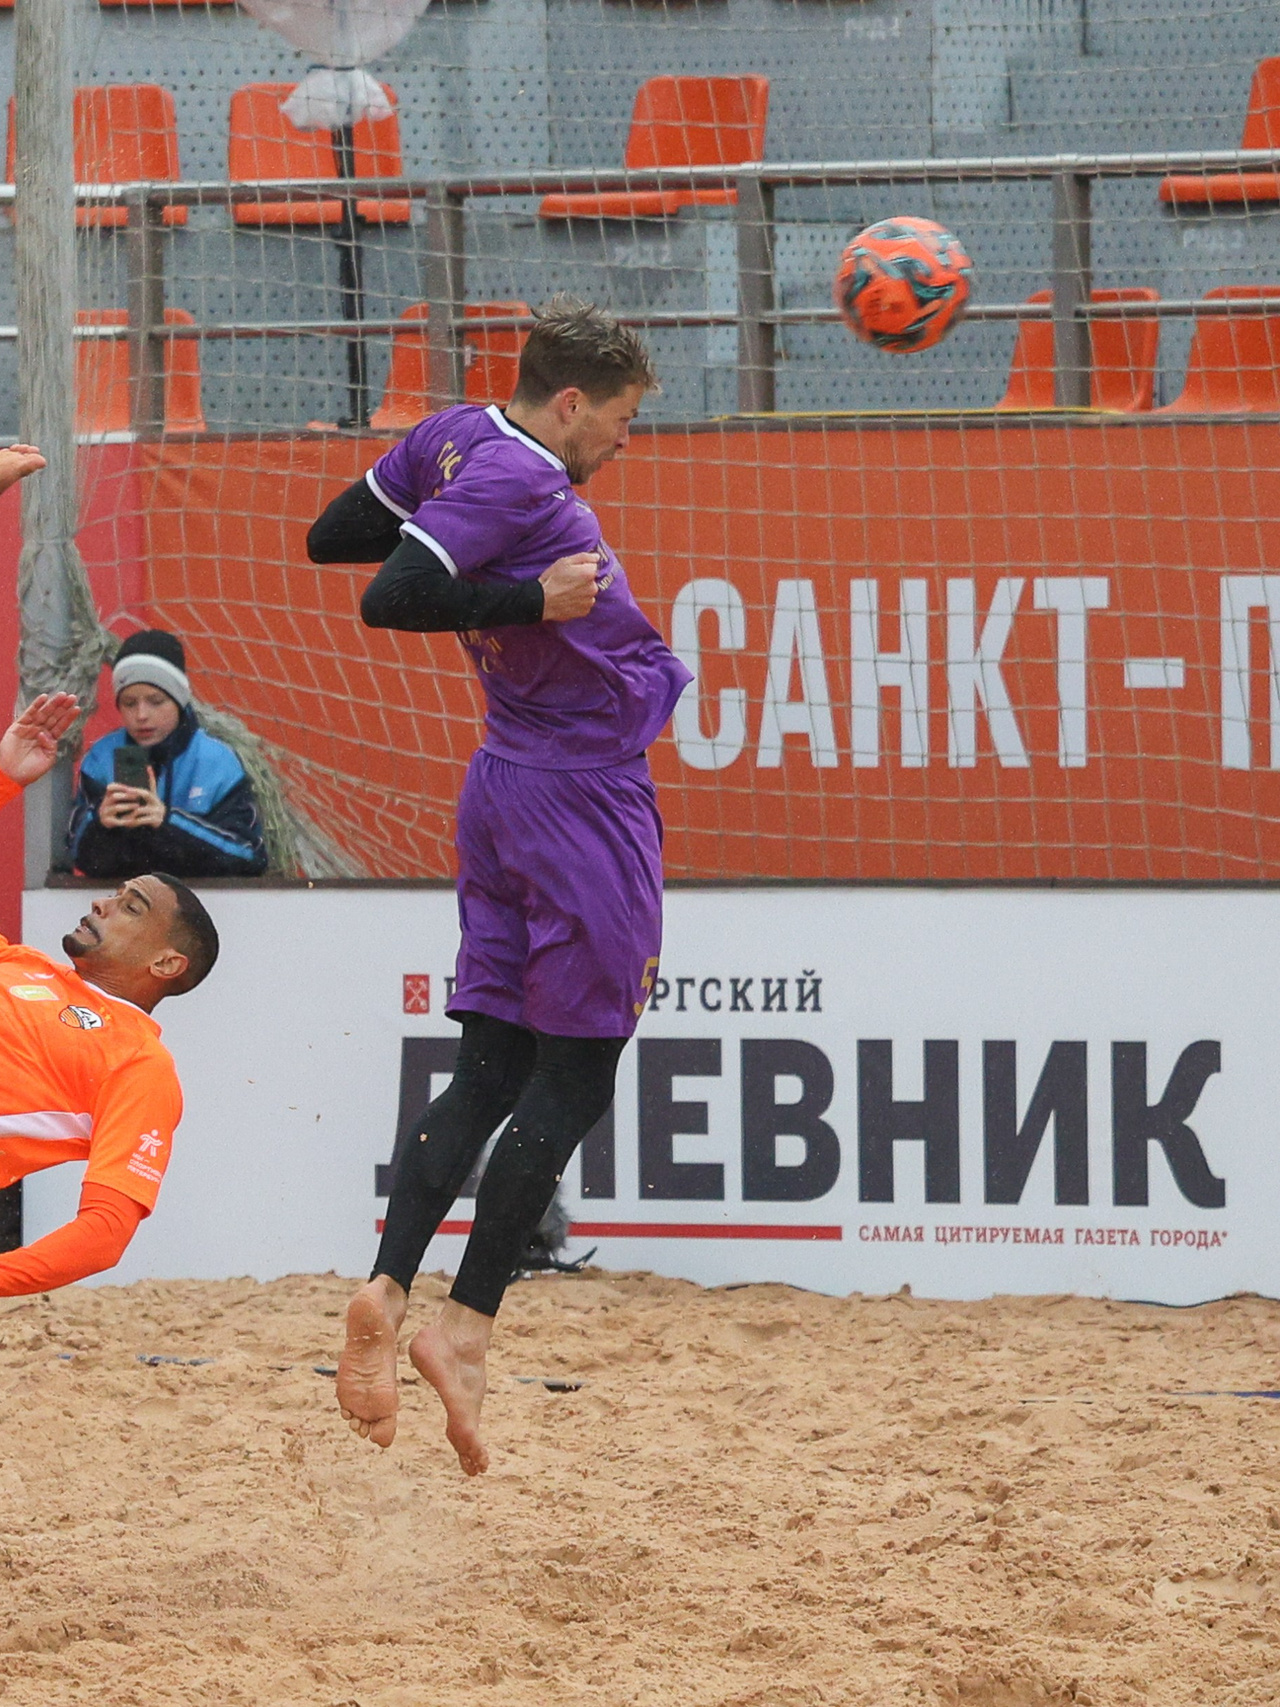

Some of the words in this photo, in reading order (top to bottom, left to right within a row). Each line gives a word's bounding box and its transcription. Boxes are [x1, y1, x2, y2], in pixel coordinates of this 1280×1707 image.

[859, 1225, 923, 1242] САМАЯ
[934, 1226, 1064, 1245] ЦИТИРУЕМАЯ
[1075, 1228, 1140, 1245] ГАЗЕТА
